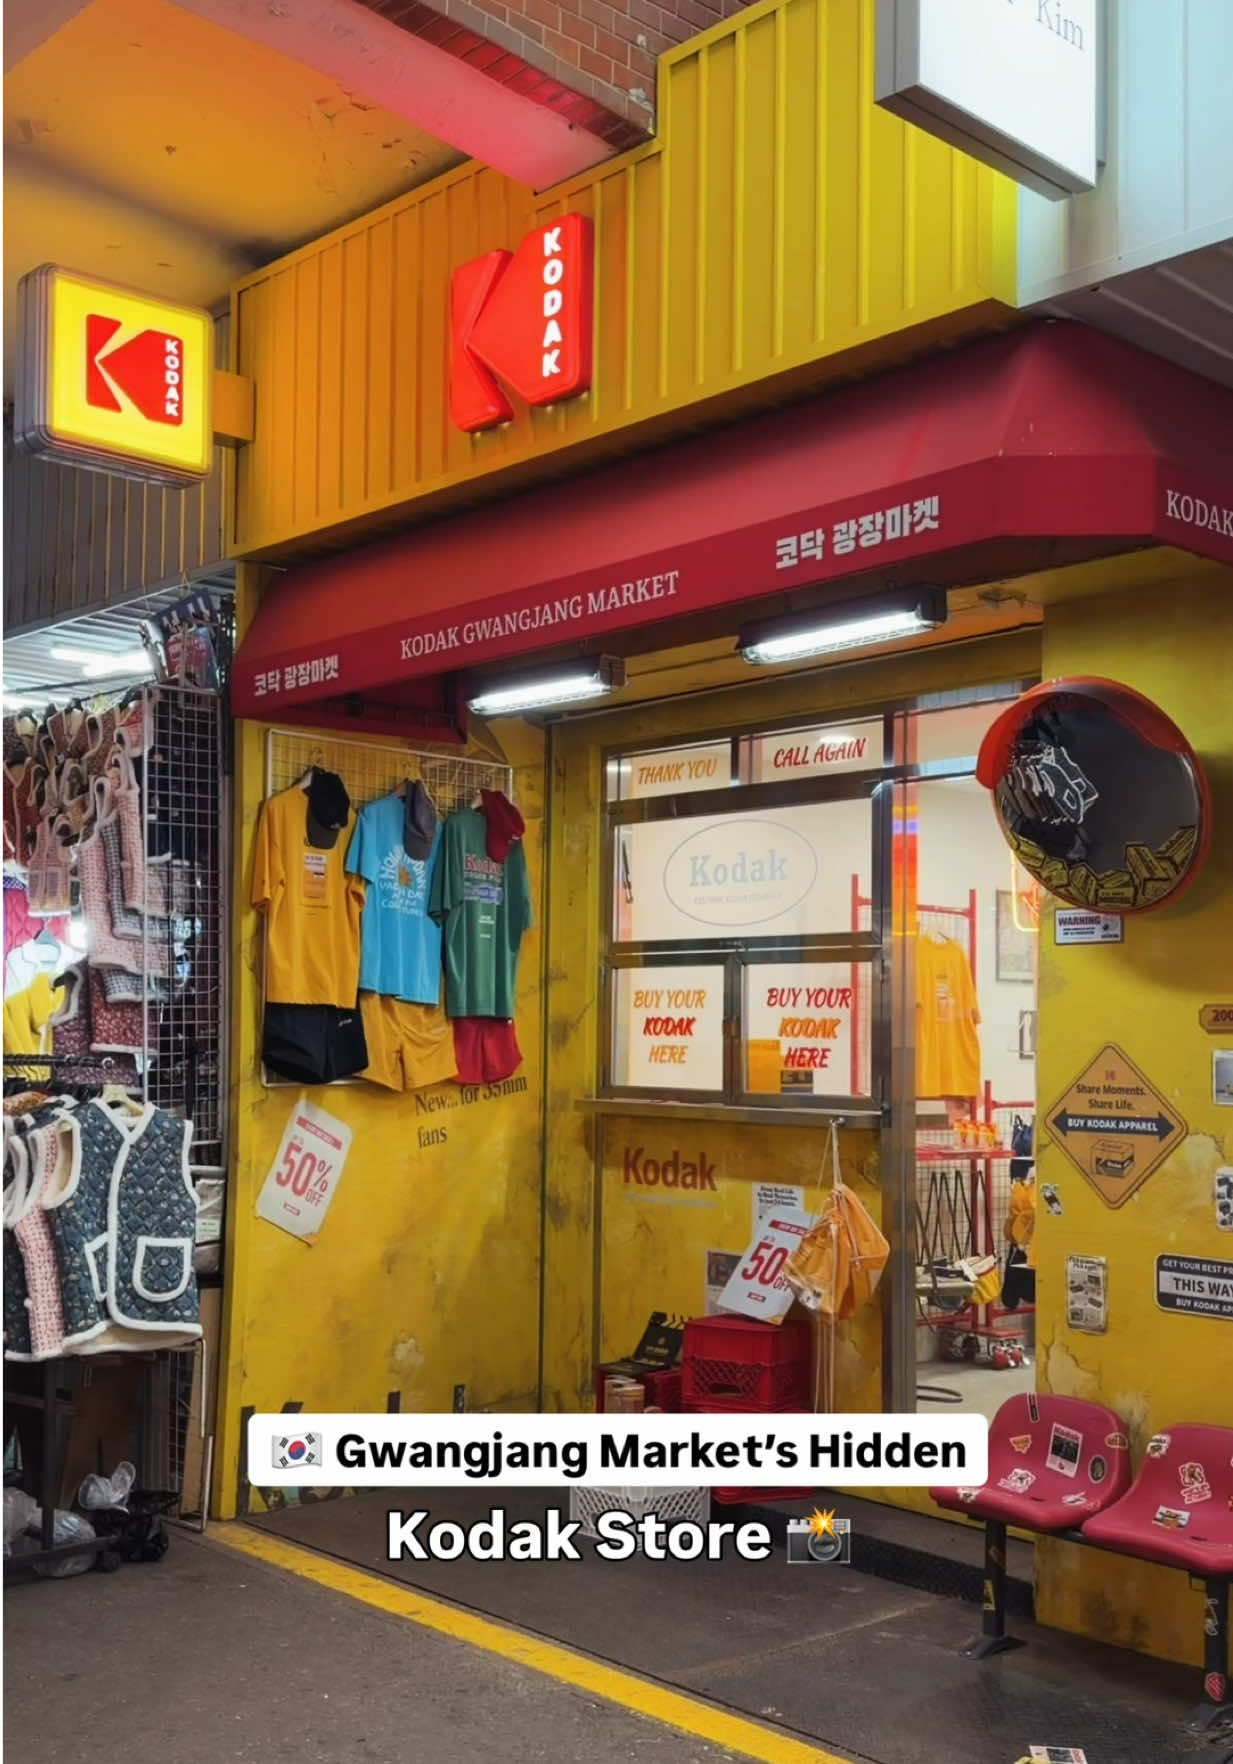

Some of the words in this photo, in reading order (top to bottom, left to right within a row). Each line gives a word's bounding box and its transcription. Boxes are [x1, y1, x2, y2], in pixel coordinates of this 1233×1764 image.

[542, 226, 564, 378] KODAK
[164, 338, 180, 417] KODAK
[1165, 488, 1233, 538] KODAK
[775, 527, 825, 570] 코닥
[832, 495, 940, 556] 광장마켓
[400, 626, 461, 660] KODAK
[462, 595, 583, 645] GWANGJANG
[586, 570, 680, 615] MARKET
[253, 668, 282, 697] 코닥
[284, 653, 340, 692] 광장마켓
[772, 746, 810, 769] CALL
[813, 737, 867, 764] AGAIN
[637, 762, 683, 785] THANK
[687, 757, 719, 779] YOU
[688, 849, 789, 888] Kodak
[632, 988, 664, 1009] BUY
[666, 988, 707, 1009] YOUR
[766, 986, 802, 1009] BUY
[805, 986, 853, 1009] YOUR
[643, 1015, 696, 1037] KODAK
[778, 1016, 842, 1039] KODAK
[648, 1044, 689, 1064] HERE
[783, 1046, 832, 1069] HERE
[459, 1083, 480, 1106] for
[482, 1075, 528, 1101] 35mm
[1075, 1083, 1101, 1095] Share
[1102, 1084, 1147, 1096] Moments.
[1087, 1098, 1114, 1110] Share
[1115, 1099, 1135, 1111] Life.
[1067, 1117, 1086, 1128] BUY
[1087, 1118, 1117, 1129] KODAK
[1118, 1120, 1158, 1132] APPAREL
[416, 1125, 448, 1150] fans
[623, 1146, 718, 1192] Kodak
[305, 1189, 325, 1207] OFF
[741, 1241, 789, 1286] 50
[1162, 1258, 1178, 1268] GET
[1179, 1261, 1200, 1271] YOUR
[1201, 1263, 1222, 1273] BEST
[772, 1276, 790, 1293] OFF
[1173, 1276, 1205, 1294] THIS
[1175, 1297, 1192, 1307] BUY
[1193, 1300, 1221, 1312] KODAK
